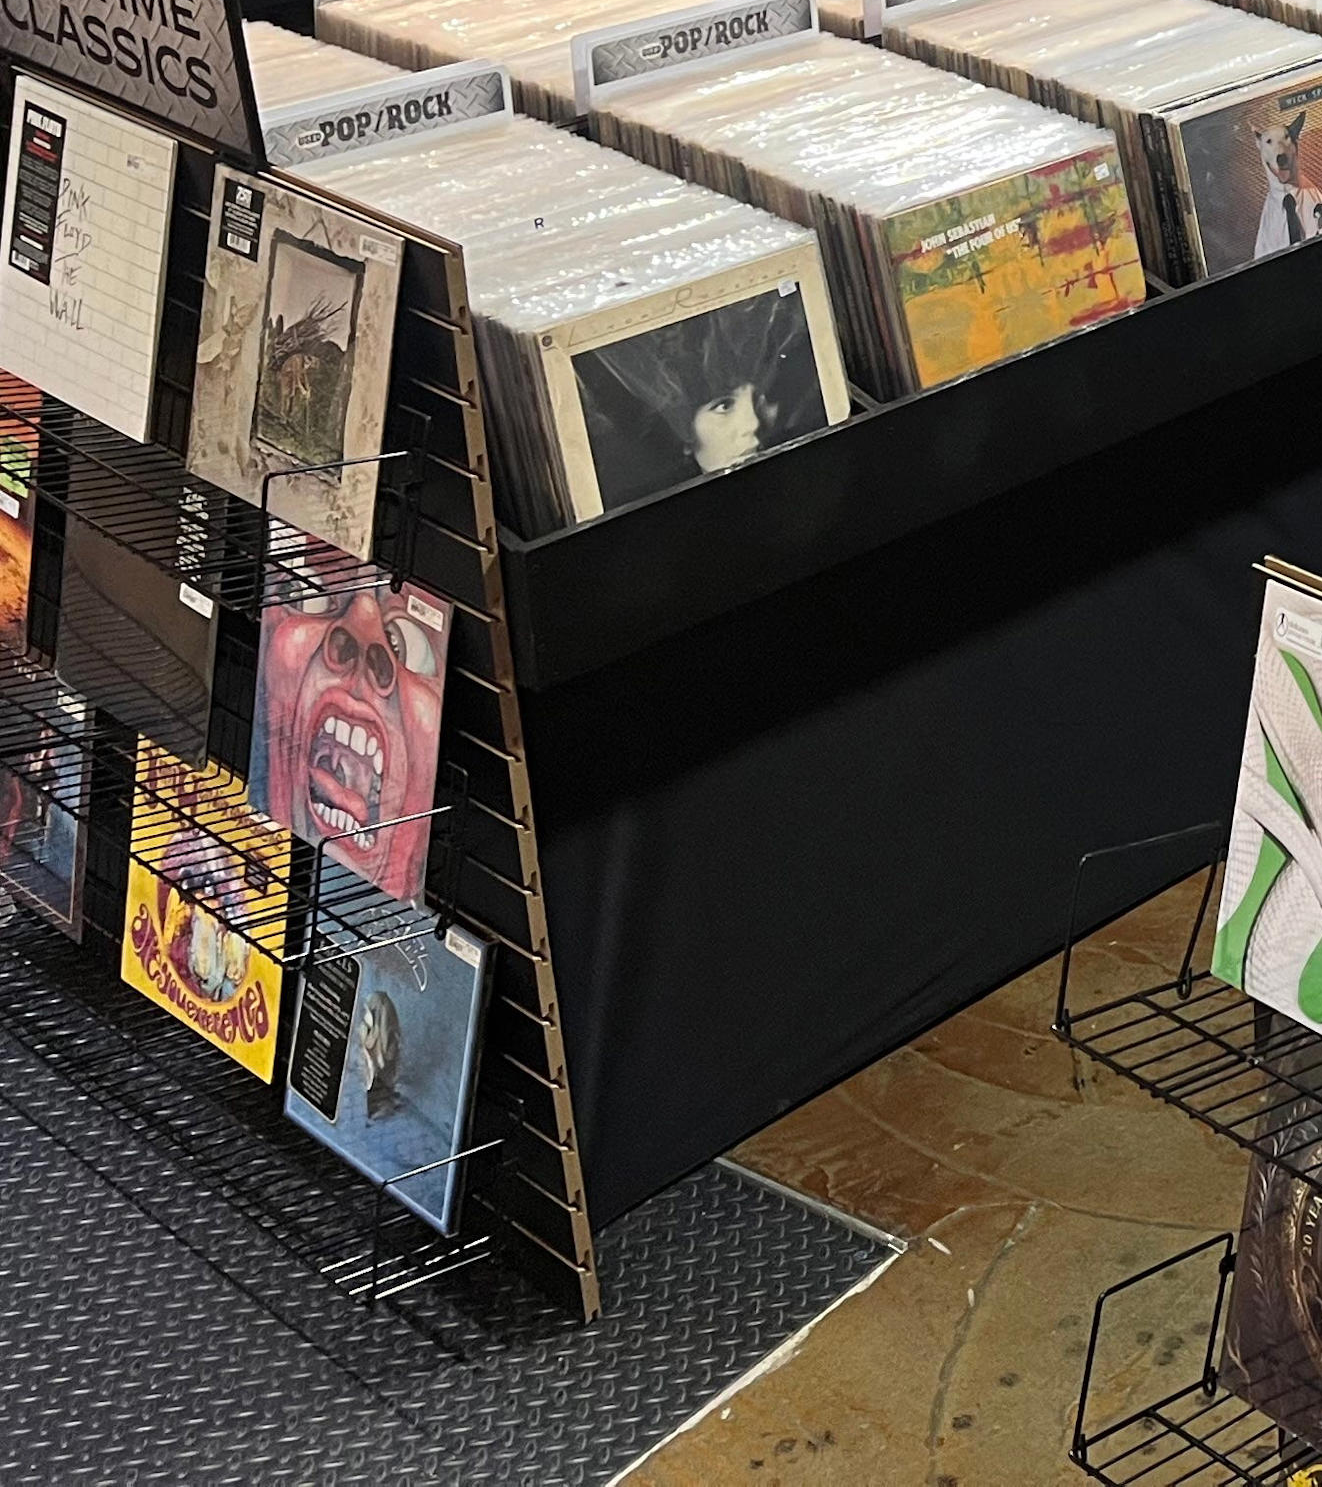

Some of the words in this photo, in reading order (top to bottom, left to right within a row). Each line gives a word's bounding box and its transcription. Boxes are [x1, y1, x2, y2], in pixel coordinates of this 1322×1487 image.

[660, 9, 770, 59] POP/ROCK
[318, 91, 452, 148] POP/ROCK
[59, 178, 90, 223] PINK
[55, 209, 92, 251] FLOYD
[533, 217, 545, 230] R
[921, 230, 946, 253] JOHN
[945, 215, 996, 242] SEBASTIAN
[48, 286, 85, 332] WALL
